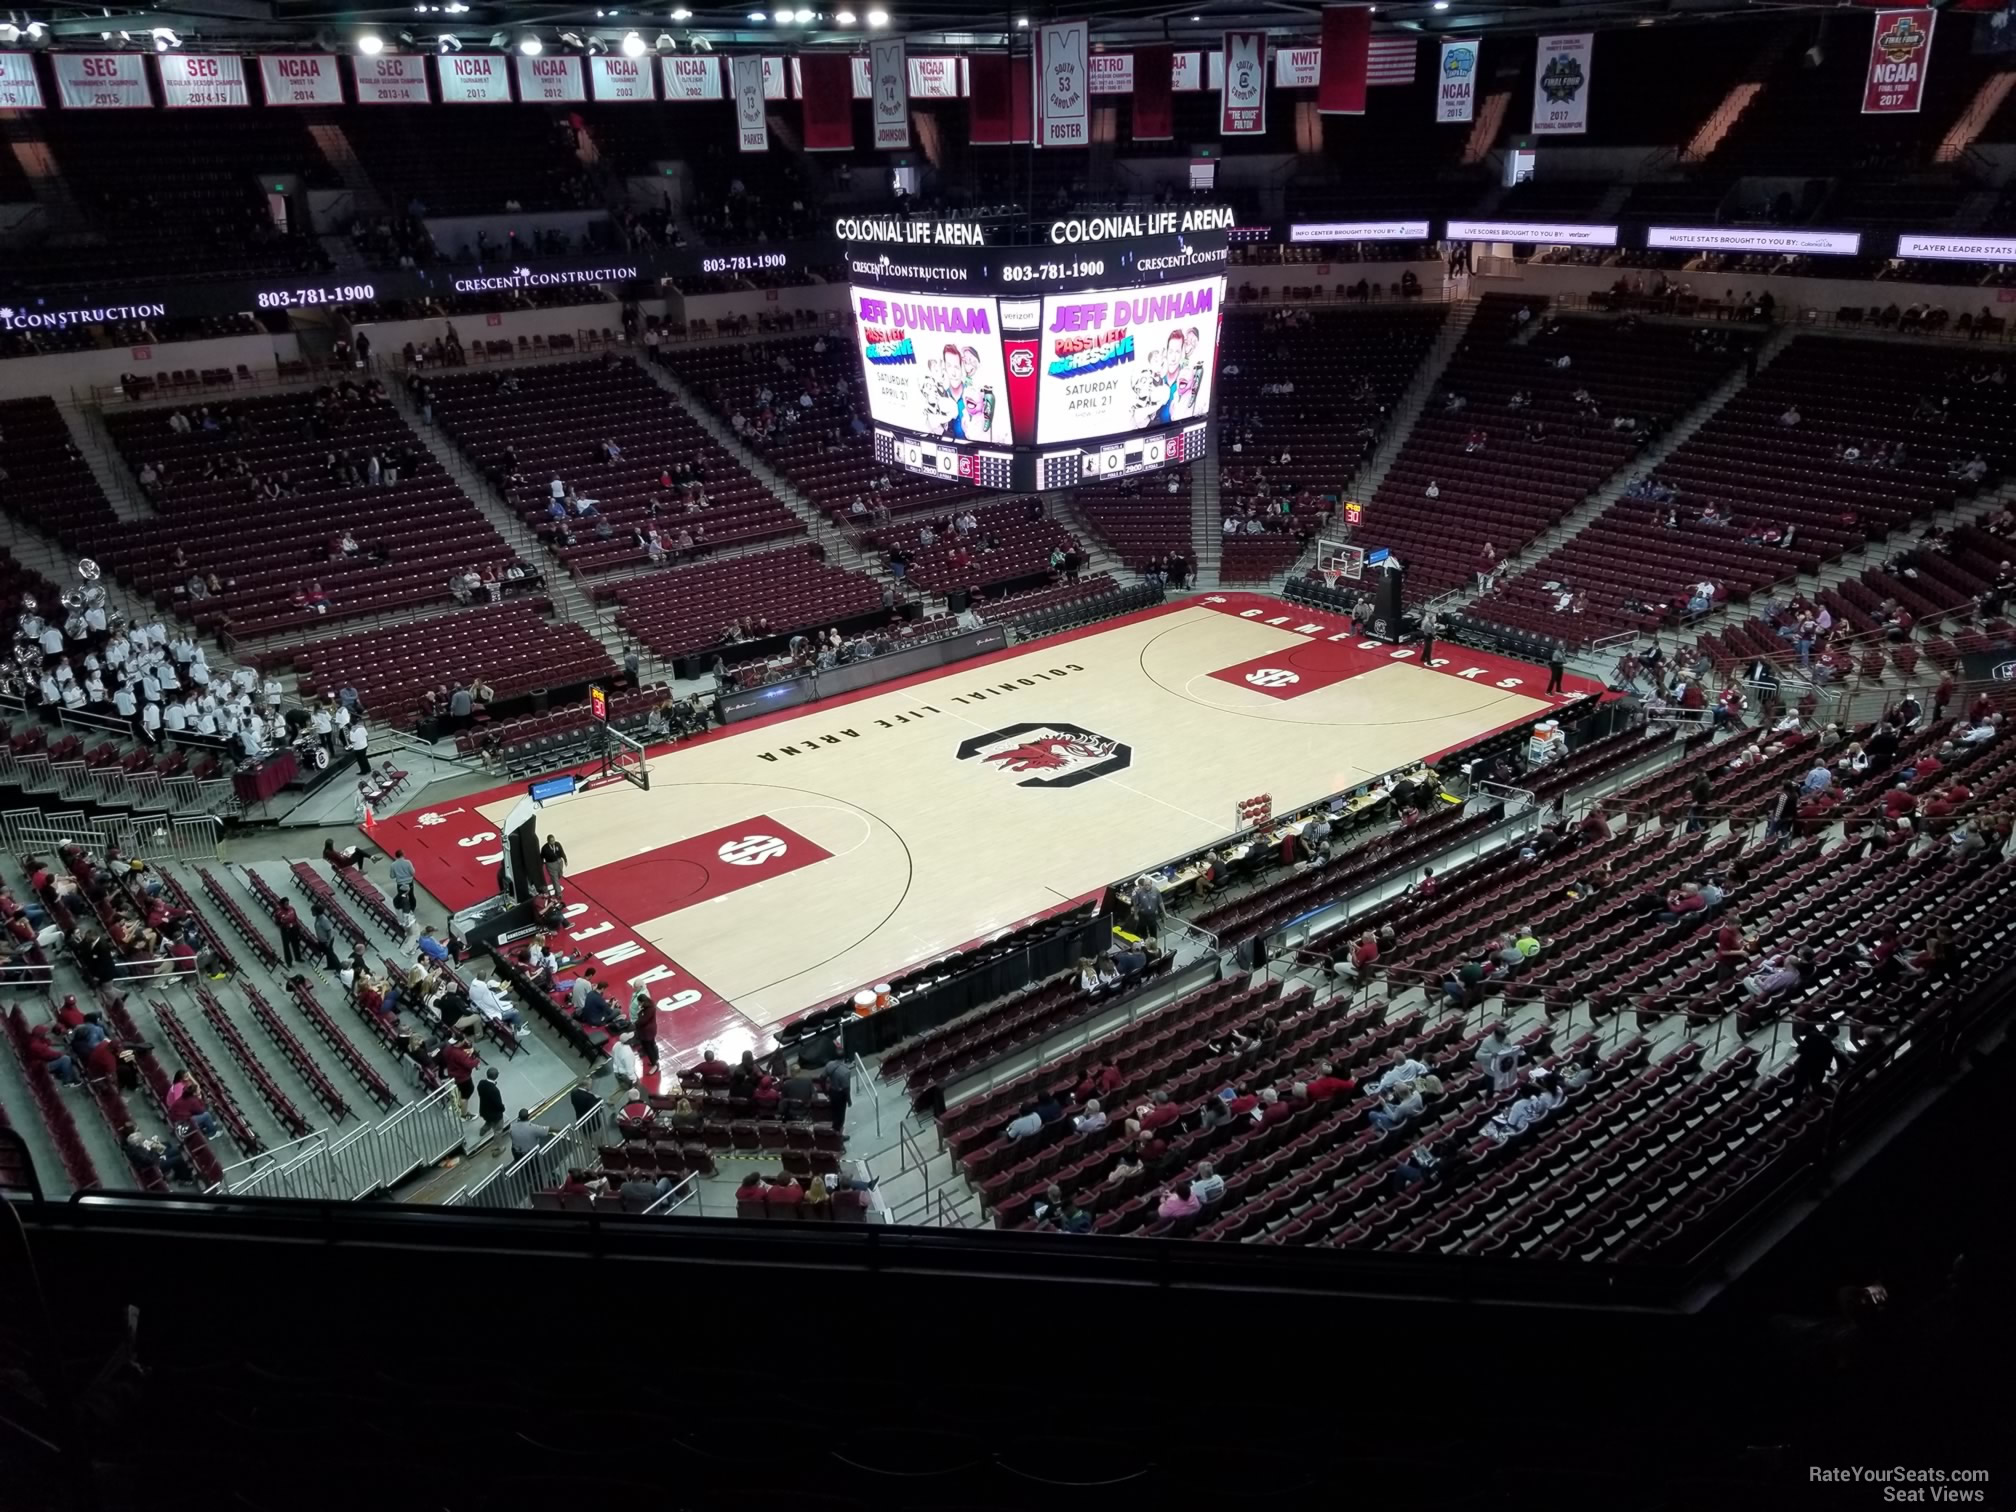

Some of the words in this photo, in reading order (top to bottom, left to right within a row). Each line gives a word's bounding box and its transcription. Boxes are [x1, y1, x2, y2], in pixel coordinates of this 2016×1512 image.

[1902, 35, 1919, 43] FOUR
[1089, 58, 1124, 72] METRO
[1236, 60, 1254, 72] SOUTH
[1291, 51, 1319, 66] NWIT
[83, 58, 117, 76] SEC
[187, 59, 218, 76] SEC
[278, 59, 320, 77] NCAA
[377, 60, 403, 76] SEC
[454, 60, 491, 75] NCAA
[532, 60, 567, 76] NCAA
[606, 60, 639, 75] NCAA
[675, 60, 707, 76] NCAA
[919, 61, 944, 75] NCAA
[1054, 63, 1075, 75] SOUTH
[1873, 62, 1918, 83] NCAA
[1059, 77, 1071, 92] 53
[1544, 78, 1562, 87] FINAL
[1563, 77, 1580, 86] FOUR
[190, 93, 227, 103] 2014-15
[294, 91, 314, 100] 2014
[378, 89, 409, 99] 2013-14
[467, 89, 486, 98] 2013
[544, 89, 562, 97] 2012
[616, 88, 633, 96] 2003
[686, 88, 702, 96] 2002
[885, 87, 894, 101] 14
[1231, 86, 1258, 100] CAROLINA
[1442, 83, 1470, 99] NCAA
[95, 94, 119, 104] 2015
[747, 97, 754, 109] 13
[1050, 92, 1080, 109] CAROLINA
[1880, 95, 1904, 106] 2017
[1447, 109, 1463, 117] 2015
[1550, 111, 1568, 120] 2017
[878, 128, 907, 142] JOHNSON
[1051, 123, 1081, 138] FOSTER
[744, 133, 764, 145] PARKER
[836, 218, 903, 242] COLONIAL
[906, 222, 930, 244] LIFE
[934, 223, 985, 245] ARENA
[1051, 215, 1143, 244] COLONIAL
[1148, 212, 1177, 235] LIFE
[1180, 207, 1235, 232] ARENA
[1913, 244, 1945, 252] PLAYER
[1947, 245, 1982, 253] LEADER
[1984, 246, 2012, 254] STATS
[703, 254, 786, 272] 803-781-1900
[852, 261, 884, 275] CRESCENT
[889, 264, 968, 280] CONSTRUCTION
[1137, 255, 1186, 271] CRESCENT
[1003, 261, 1104, 281] 803-781-1900
[455, 276, 521, 292] CRESCENT
[529, 267, 637, 285] CONSTRUCTION
[258, 285, 374, 308] 803-781-1900
[14, 304, 165, 328] CONSTRUCTION
[859, 297, 888, 325] JEFF
[891, 302, 991, 335] DUNHAM
[1004, 312, 1034, 320] verizon
[1049, 302, 1108, 333] JEFF
[1114, 287, 1213, 327] DUNHAM
[1055, 327, 1128, 356] PASSIVELY
[877, 372, 909, 387] SATURDAY
[881, 386, 898, 399] APRIL
[900, 391, 908, 401] 21
[1065, 379, 1119, 396] SATURDAY
[1068, 397, 1098, 410] APRIL
[1101, 395, 1112, 406] 21
[910, 449, 917, 463] 0
[1150, 446, 1159, 460] 0
[944, 456, 952, 471] 0
[1108, 454, 1118, 469] 0
[1125, 463, 1143, 473] 29:00
[1347, 510, 1359, 523] 30
[1239, 609, 1524, 689] GAMECOCKS
[952, 664, 1084, 706] COLONIAL
[1245, 669, 1300, 688] SEC
[874, 706, 941, 729] LIFE
[757, 728, 860, 763] ARENA
[717, 835, 787, 865] SEC
